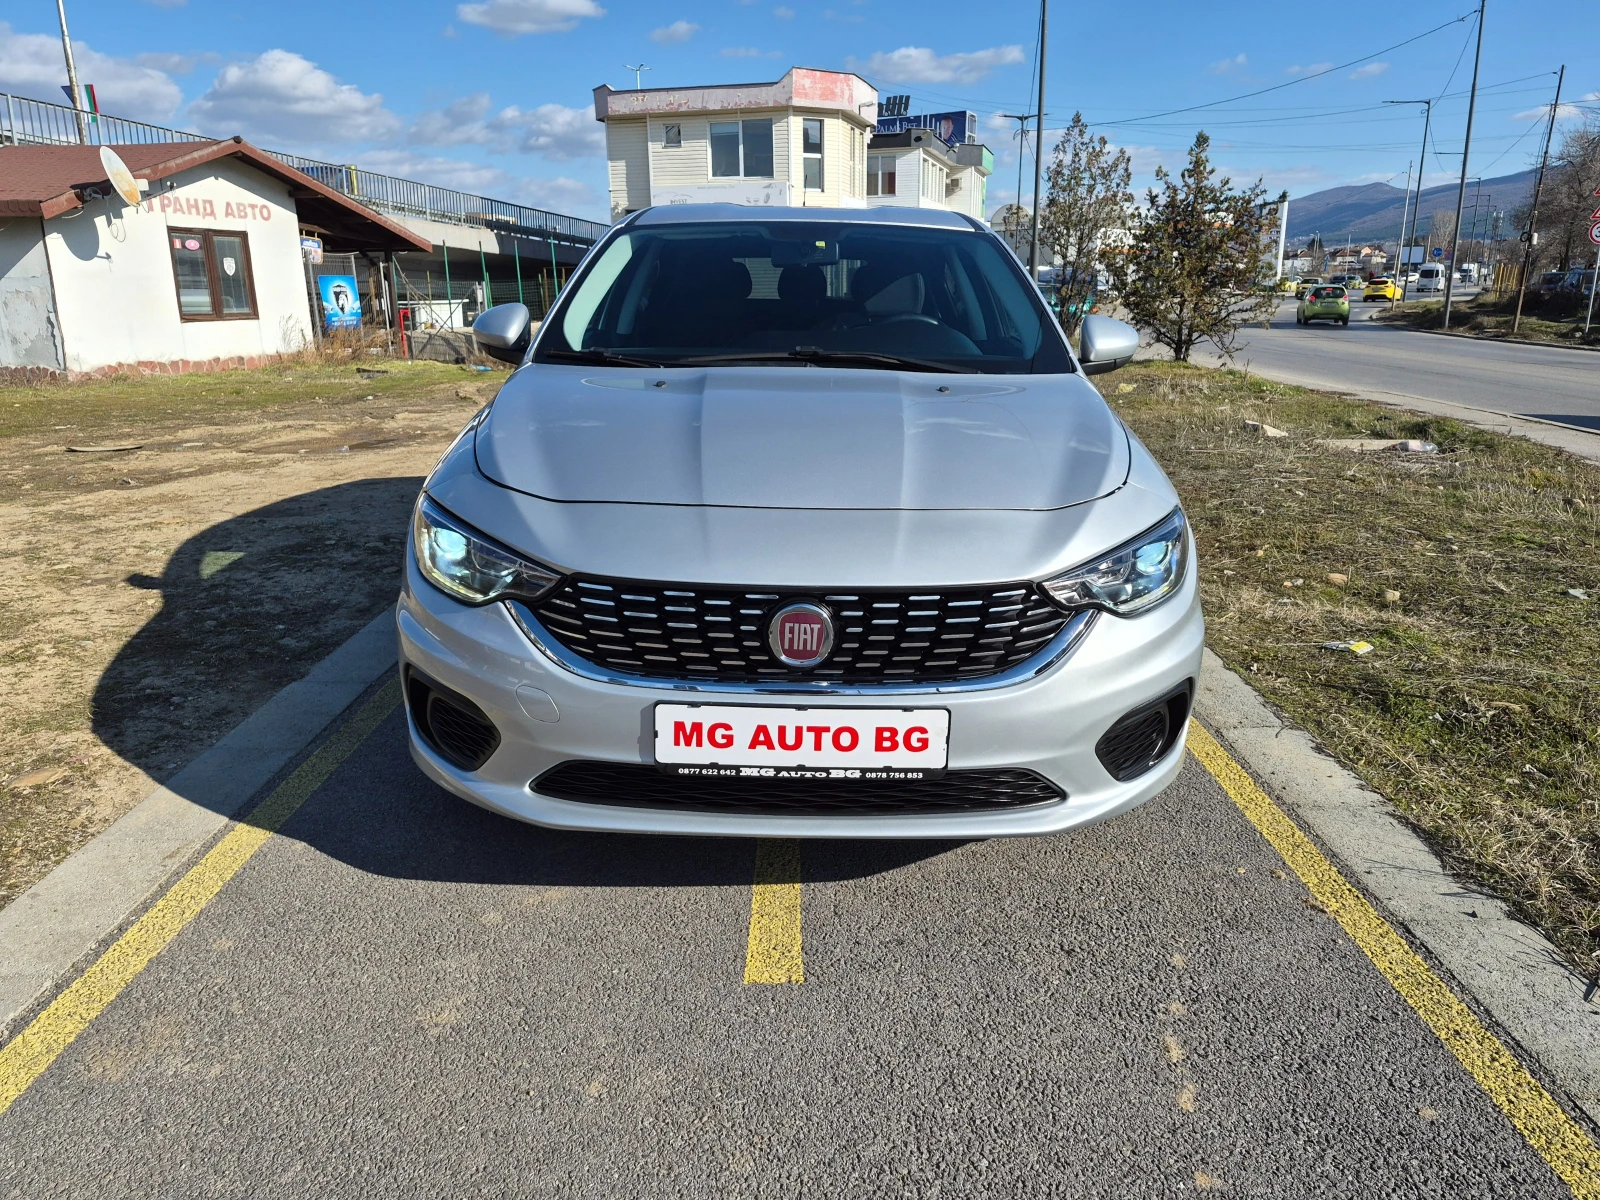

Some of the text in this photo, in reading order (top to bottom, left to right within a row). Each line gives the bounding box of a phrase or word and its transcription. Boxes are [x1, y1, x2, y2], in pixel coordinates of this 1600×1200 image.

[147, 194, 272, 222] ГРАНД АВТО
[784, 622, 821, 650] FIAT
[673, 721, 930, 752] MG AUTO BG
[678, 767, 700, 775] 0877
[739, 767, 776, 777] MG
[828, 769, 863, 779] BG
[865, 771, 888, 779] 0878
